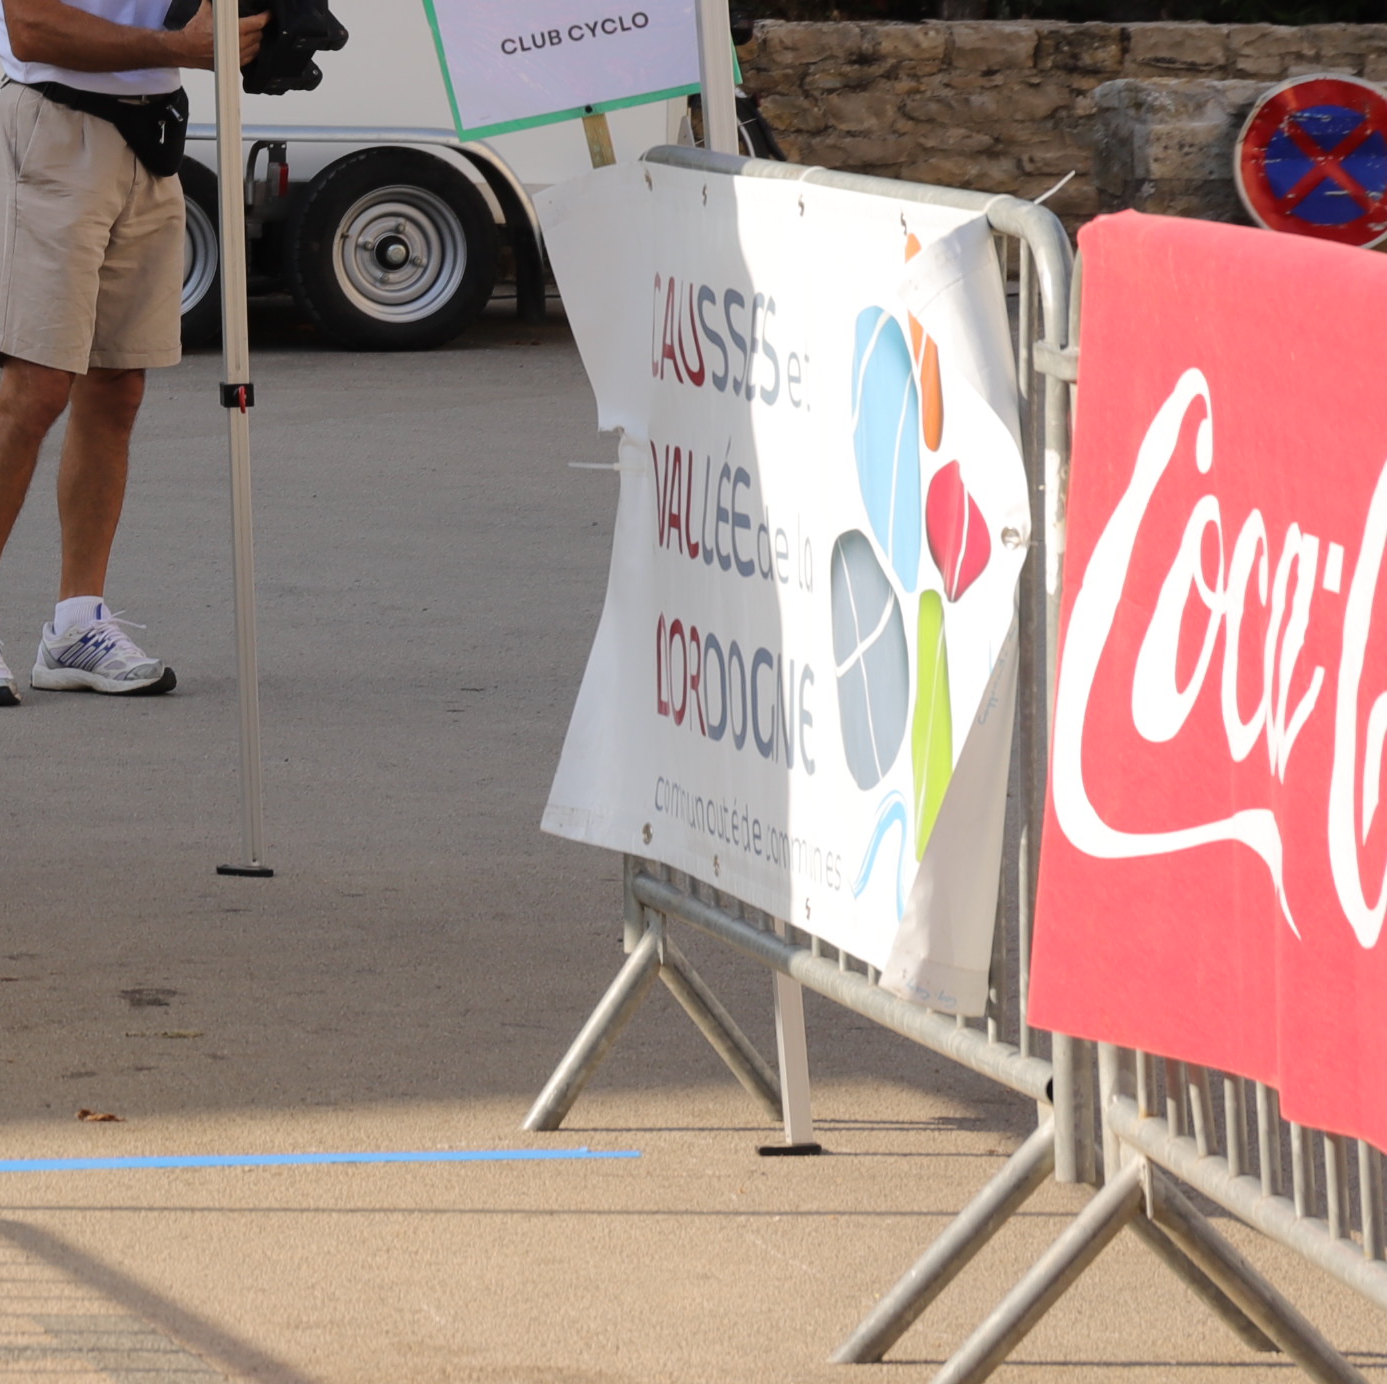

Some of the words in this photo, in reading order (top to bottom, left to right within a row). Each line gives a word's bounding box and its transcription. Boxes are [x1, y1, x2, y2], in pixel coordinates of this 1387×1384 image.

[500, 29, 563, 56] CLUB
[567, 11, 650, 43] CYCLO
[652, 271, 781, 406] CAUSSES
[650, 435, 756, 578] VALLÉE
[757, 505, 790, 584] de
[797, 511, 814, 594] la
[741, 803, 763, 857] de
